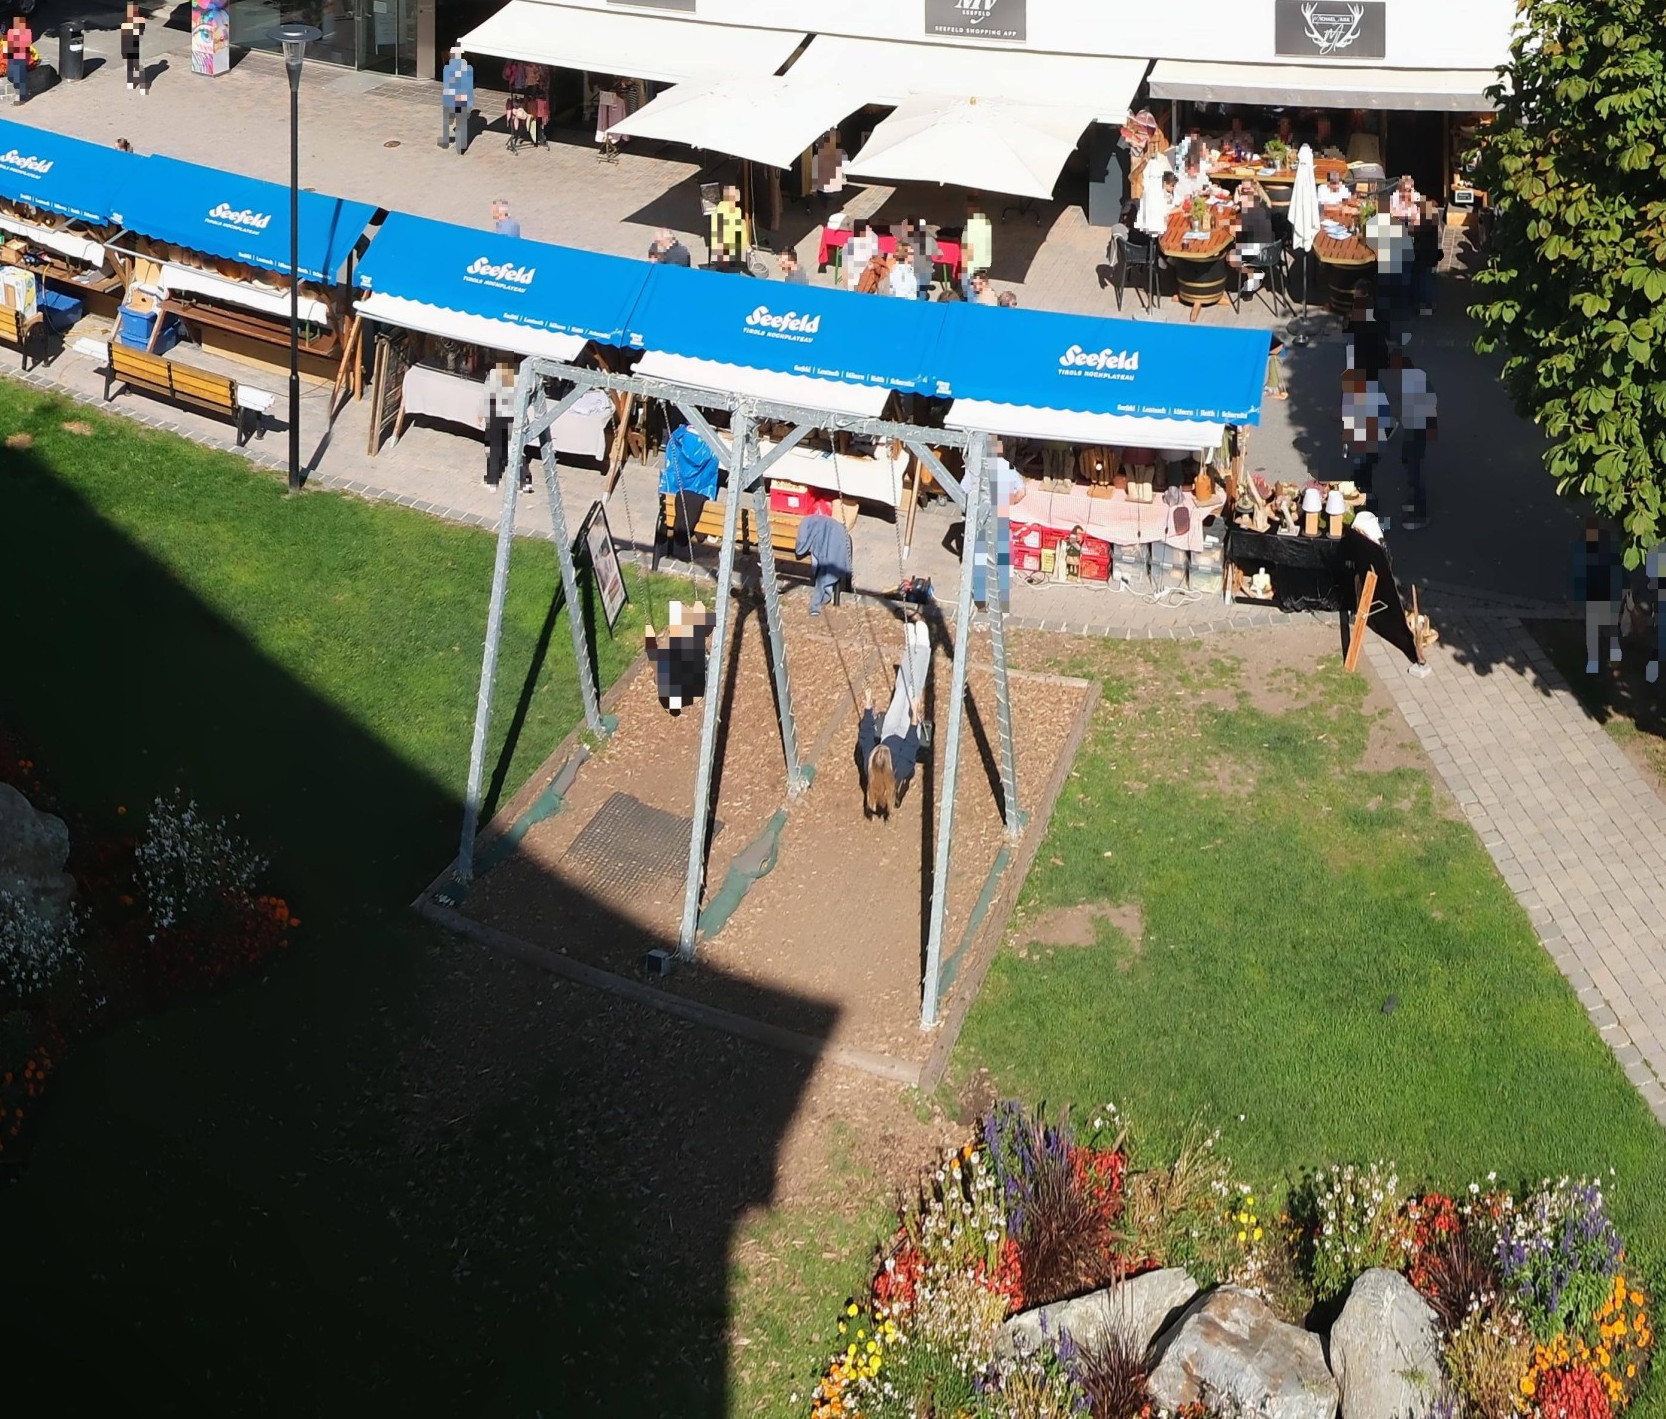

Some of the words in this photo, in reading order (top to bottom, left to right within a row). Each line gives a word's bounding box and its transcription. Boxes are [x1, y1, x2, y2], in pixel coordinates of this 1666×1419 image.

[966, 28, 1001, 36] SHOPPING
[0, 149, 54, 174] Seefeld
[208, 203, 271, 229] Seefeld
[466, 257, 536, 285] Seefeld
[745, 306, 821, 333] Seefeld
[1058, 344, 1140, 371] Seefeld
[1057, 369, 1081, 377] TIROLS
[1083, 370, 1135, 381] HOCHPLATEAU
